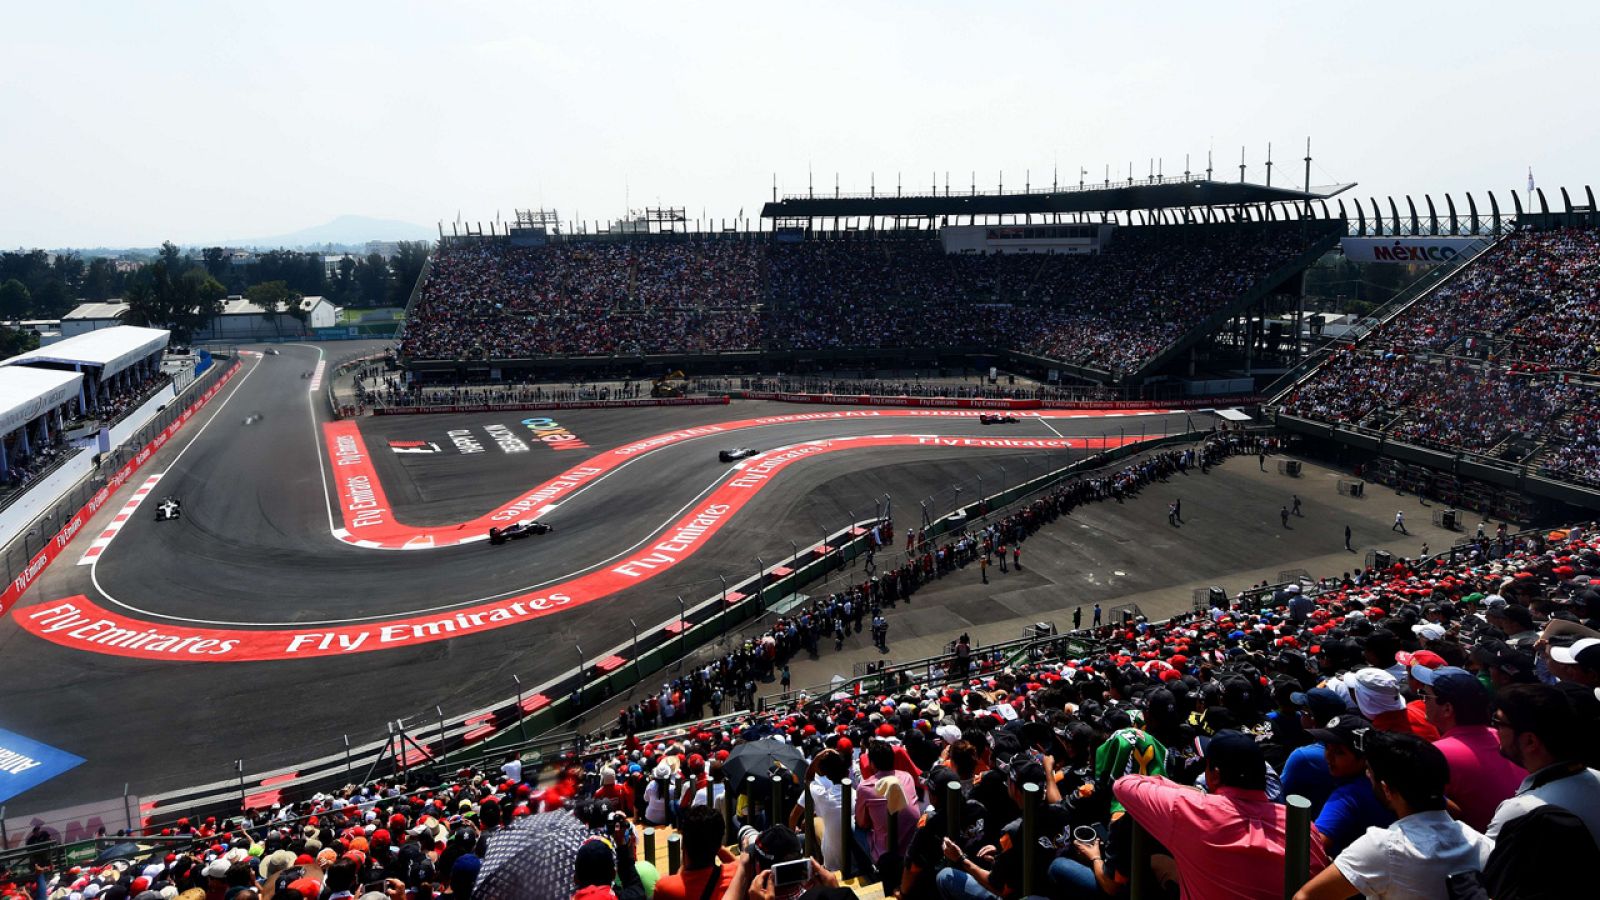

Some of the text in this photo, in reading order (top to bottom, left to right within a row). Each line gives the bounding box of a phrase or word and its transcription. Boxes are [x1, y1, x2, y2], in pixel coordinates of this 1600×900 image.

[919, 438, 1072, 447] Fly Emirates
[344, 475, 387, 528] Fly Emirates
[491, 473, 578, 522] Emirates
[57, 517, 81, 548] Fly Emirates
[612, 502, 730, 578] Fly Emirates
[15, 553, 47, 592] Fly Emirates
[29, 603, 241, 655] Fly Emirates
[285, 592, 571, 651] Fly Emirates
